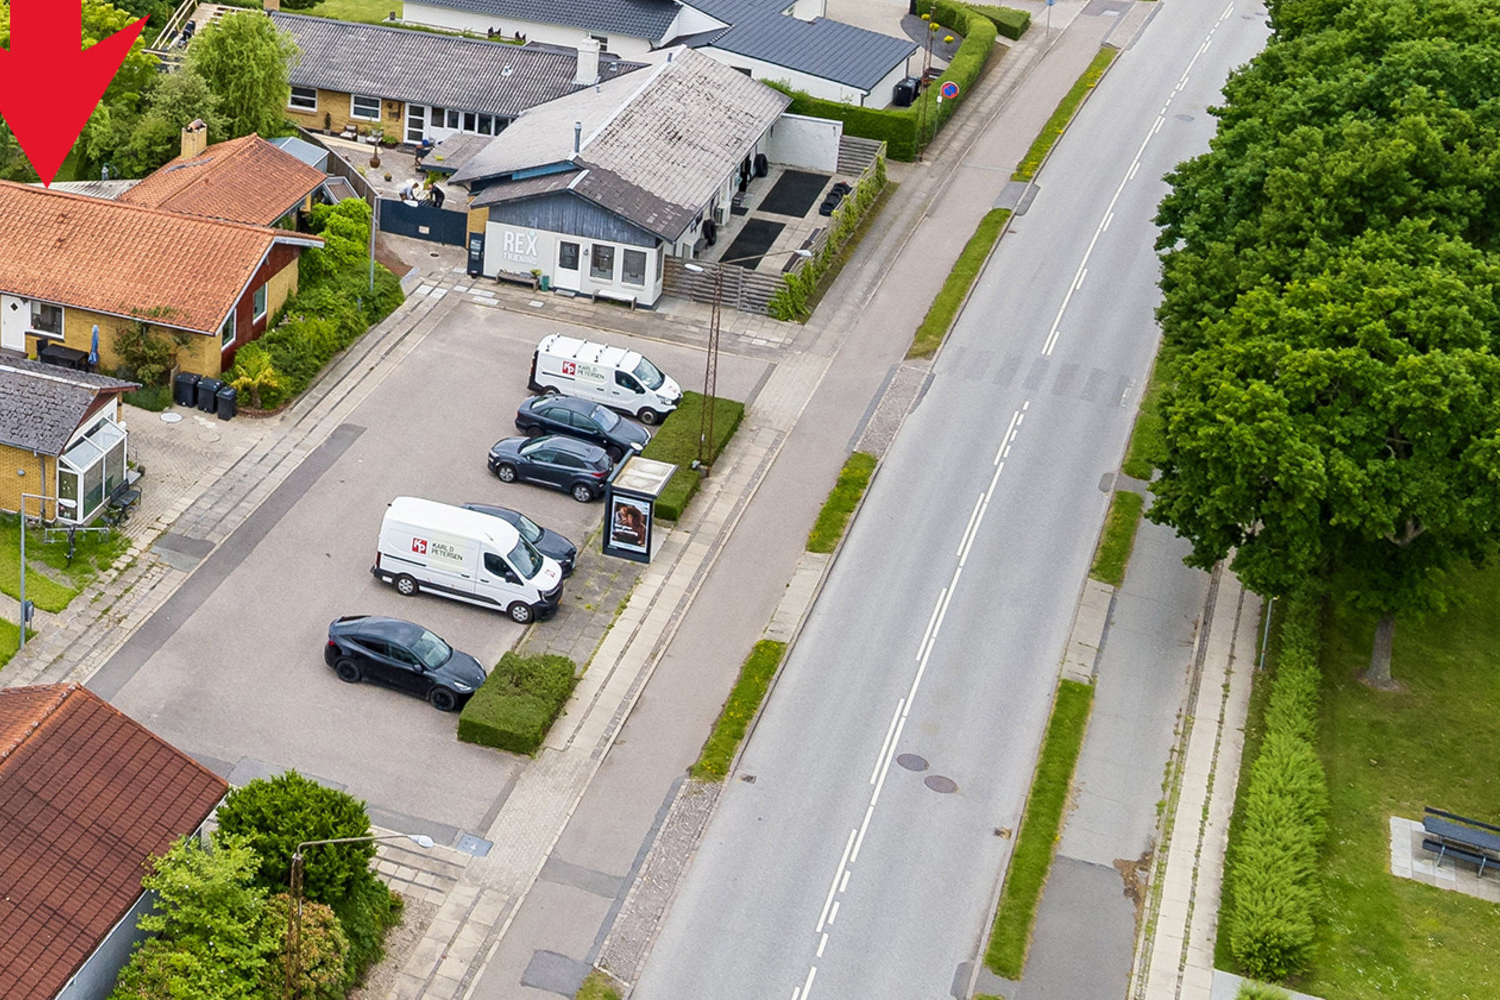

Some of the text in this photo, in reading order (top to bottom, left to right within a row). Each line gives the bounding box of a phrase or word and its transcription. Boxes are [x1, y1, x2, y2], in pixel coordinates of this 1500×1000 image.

[503, 231, 538, 257] REX
[563, 362, 575, 375] KP
[577, 370, 605, 379] PETERSEN
[413, 538, 426, 553] KP
[432, 543, 448, 552] KARL
[431, 549, 463, 560] PETERSEN
